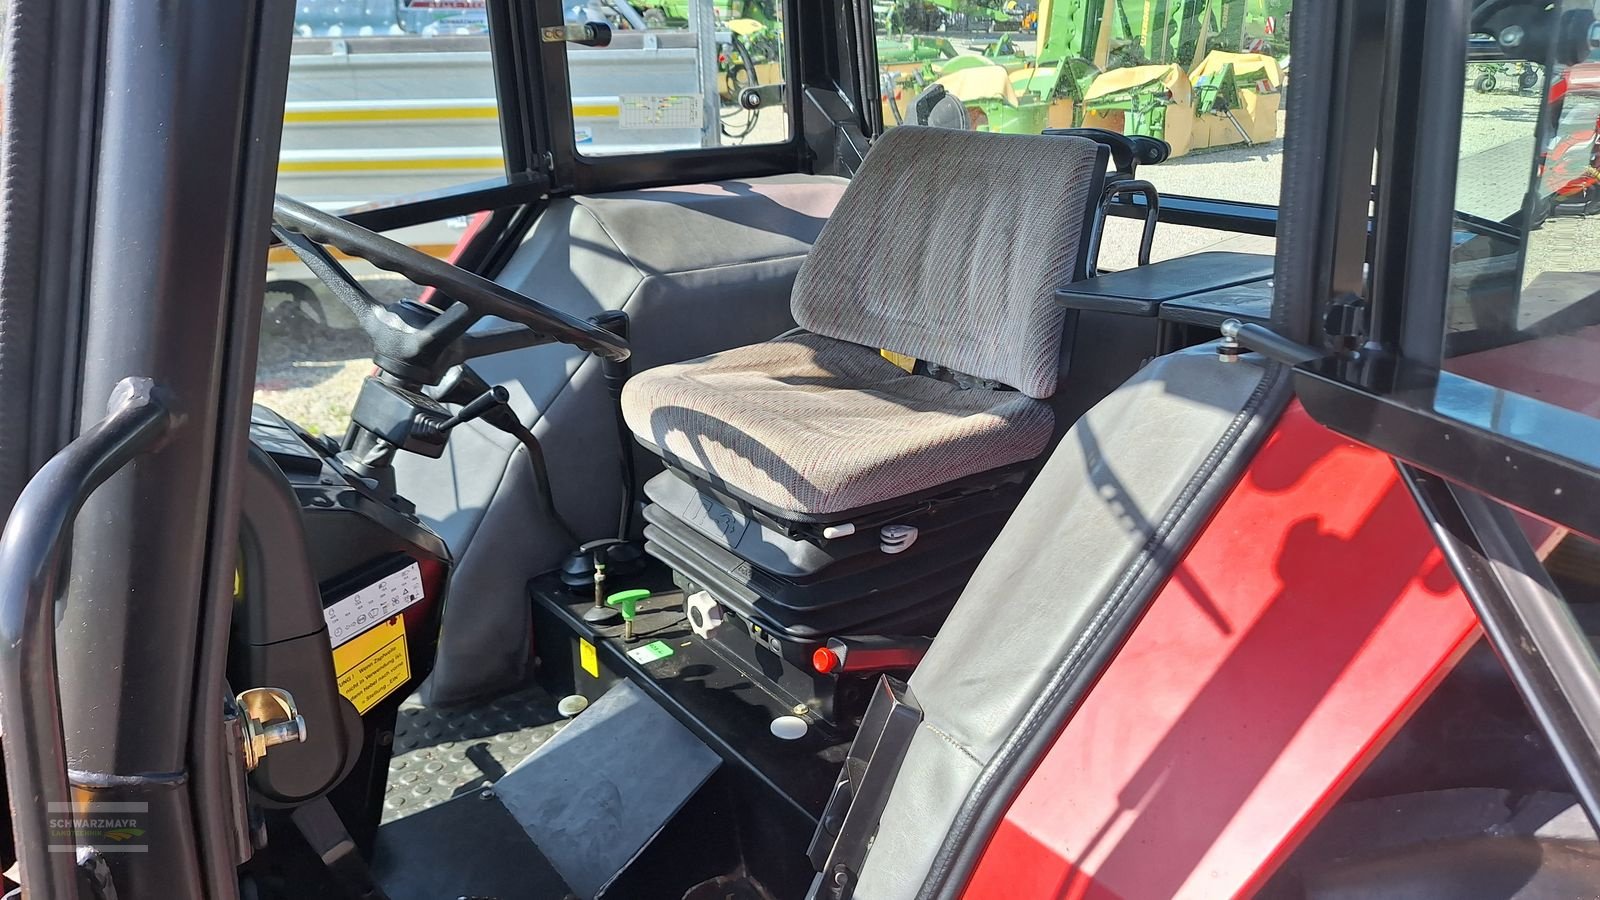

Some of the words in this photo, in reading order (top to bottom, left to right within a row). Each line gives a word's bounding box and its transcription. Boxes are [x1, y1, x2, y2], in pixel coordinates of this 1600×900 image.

[359, 662, 373, 673] Wenn
[374, 647, 396, 664] Zapfwelle
[345, 682, 359, 694] nicht
[365, 658, 394, 680] Verwendung
[363, 680, 377, 692] Hebel
[378, 671, 390, 682] nach
[391, 661, 403, 673] vorne
[366, 684, 387, 701] Stellung
